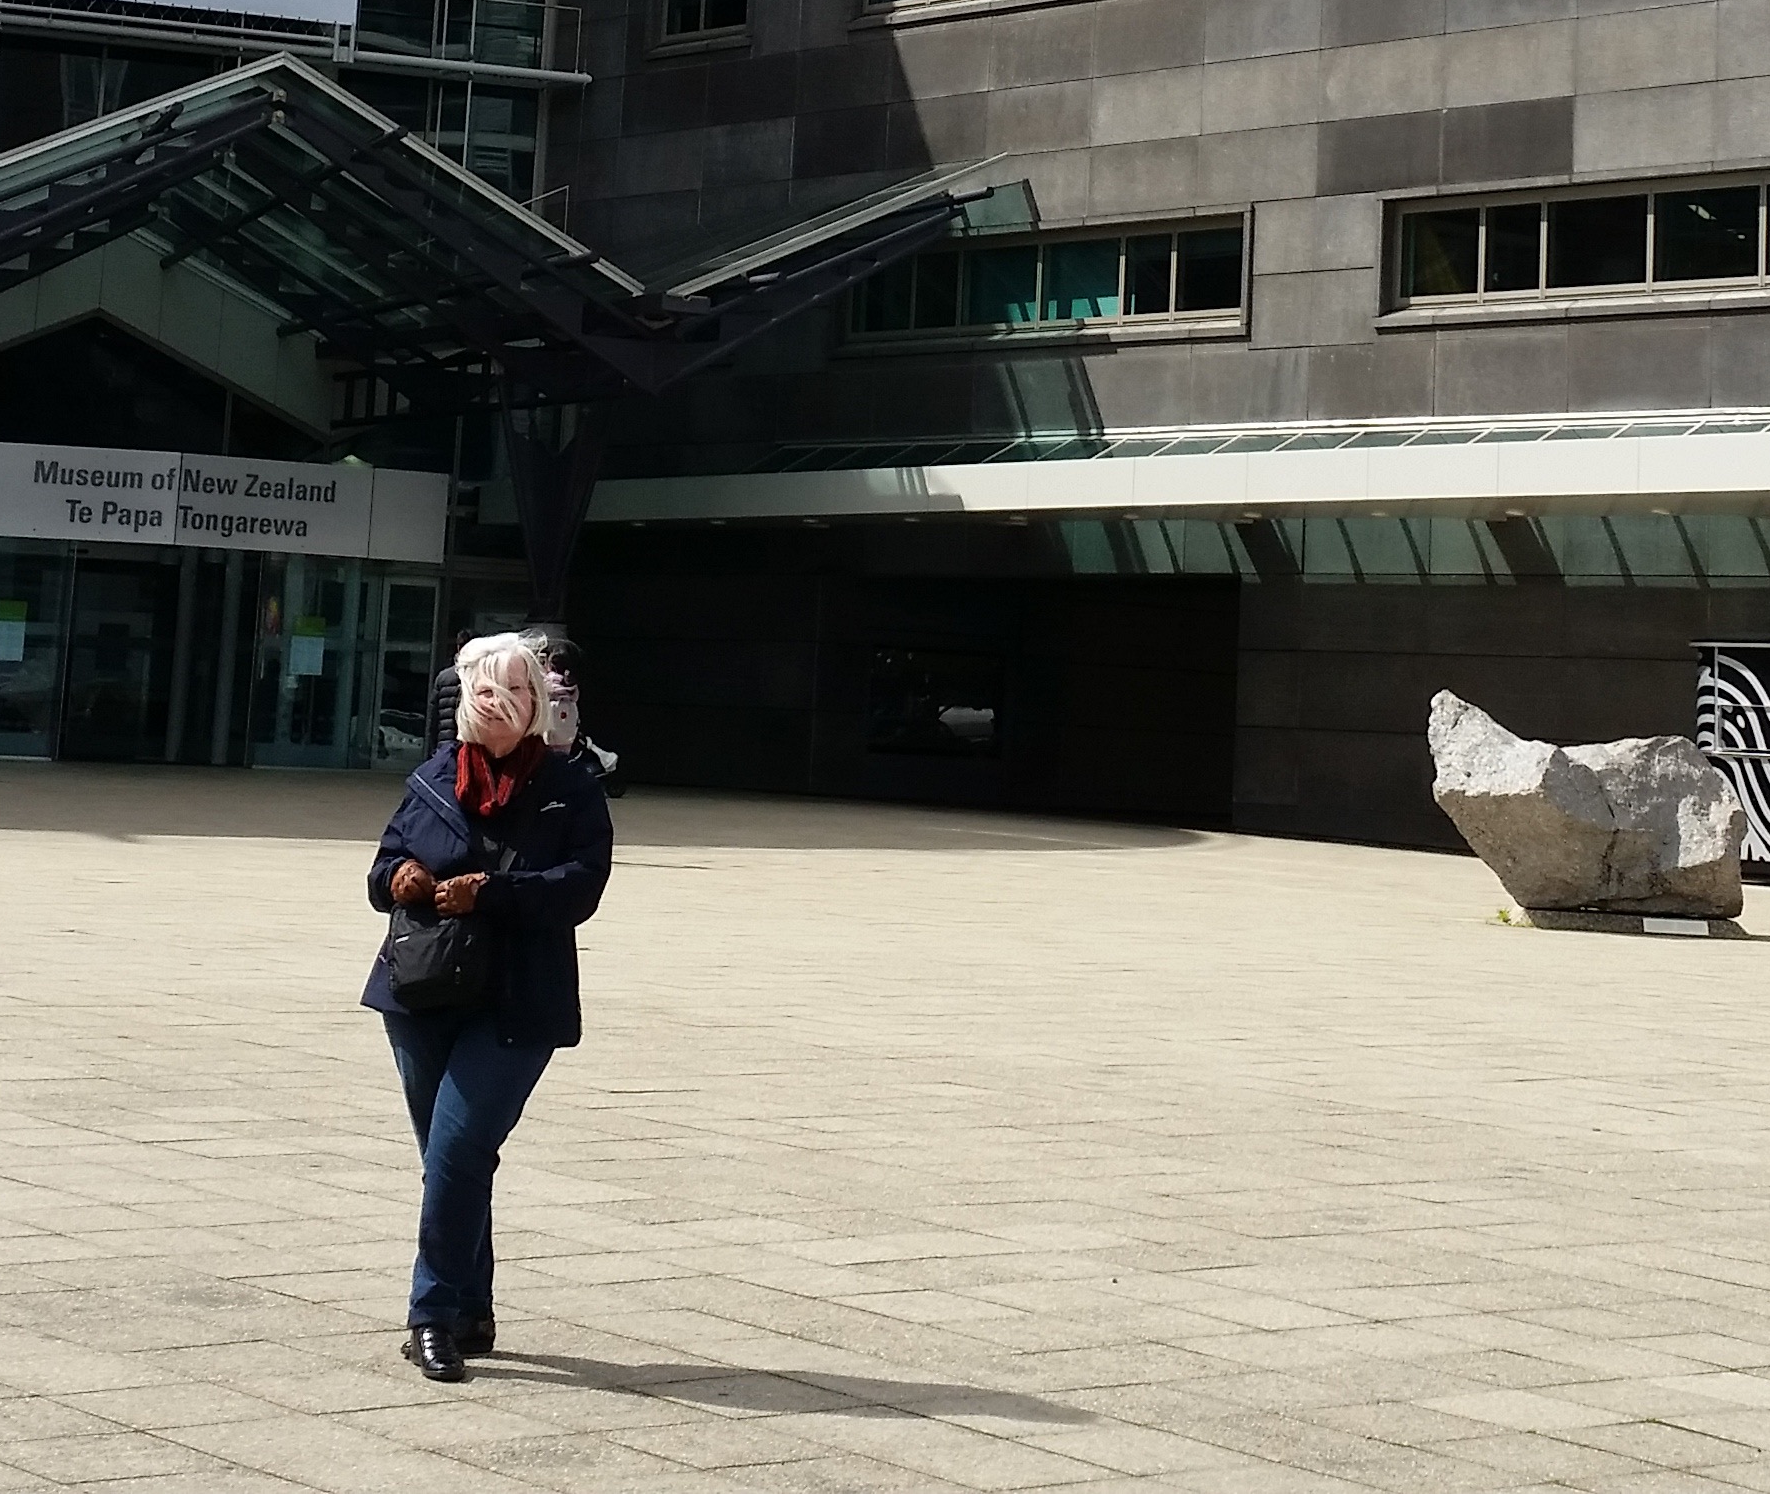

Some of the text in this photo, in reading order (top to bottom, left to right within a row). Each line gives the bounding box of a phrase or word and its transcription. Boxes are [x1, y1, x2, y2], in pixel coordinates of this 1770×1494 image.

[33, 460, 336, 503] Museum of New Zealand
[66, 499, 308, 538] Te Papa Tongarewa
